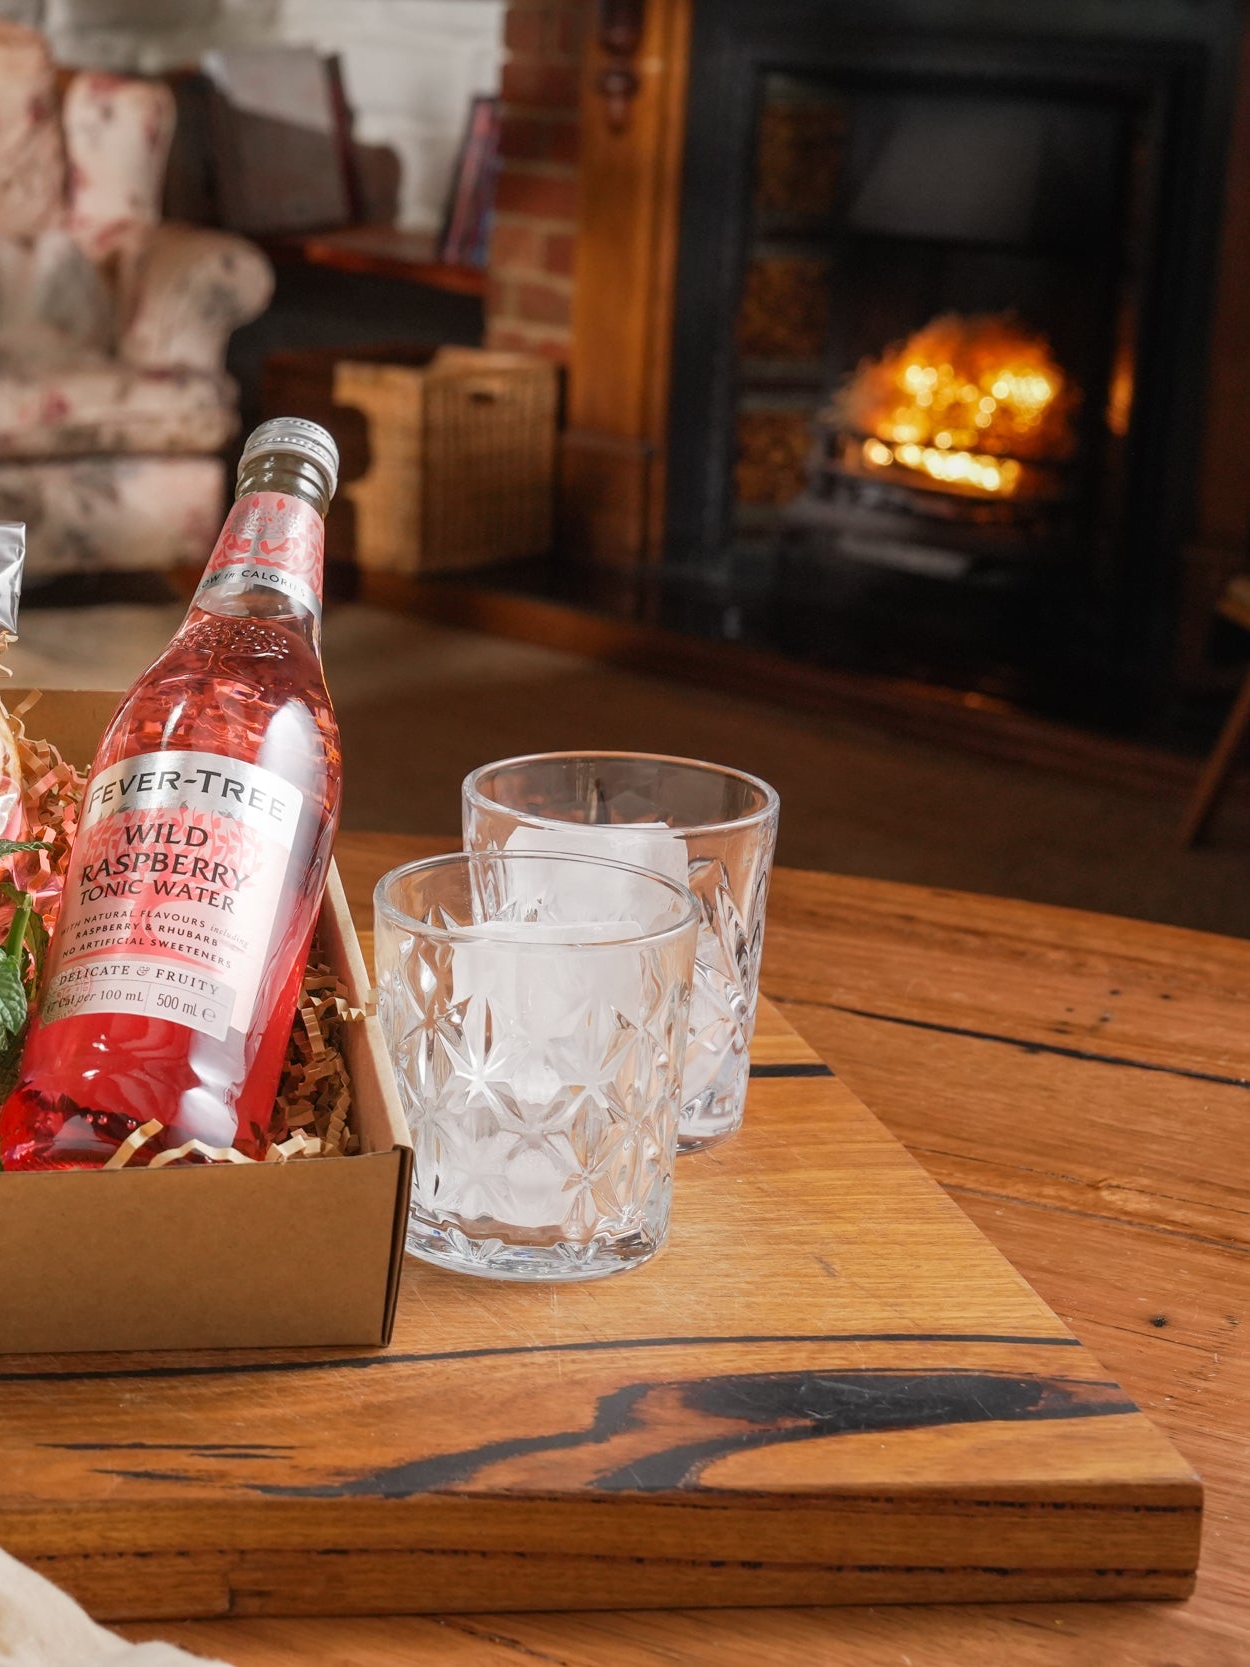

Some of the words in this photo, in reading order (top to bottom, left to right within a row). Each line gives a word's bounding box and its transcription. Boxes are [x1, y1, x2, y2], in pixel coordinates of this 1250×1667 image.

[241, 570, 306, 597] CALORIS
[86, 768, 286, 823] FEVER-TREE
[124, 822, 209, 847] WILD
[78, 851, 250, 894] RASPBERRY
[79, 879, 143, 906] TONIC
[153, 879, 236, 915] WATER
[75, 923, 140, 940] RASPBERRY
[145, 923, 152, 931] &
[158, 924, 218, 947] RHUBARB
[83, 910, 136, 924] NATURAL
[140, 910, 206, 928] FLAVOURS
[210, 925, 250, 950] including
[61, 947, 76, 959] NO
[79, 937, 145, 951] ARTIFICIAL
[150, 938, 232, 969] SWEETENERS
[59, 965, 130, 986] DELICATE
[136, 966, 150, 976] &
[155, 968, 219, 995] FRUITY
[74, 993, 96, 1007] per
[100, 989, 122, 1000] 100
[125, 991, 143, 1002] mL
[156, 993, 180, 1010] 500
[182, 1002, 197, 1017] mL
